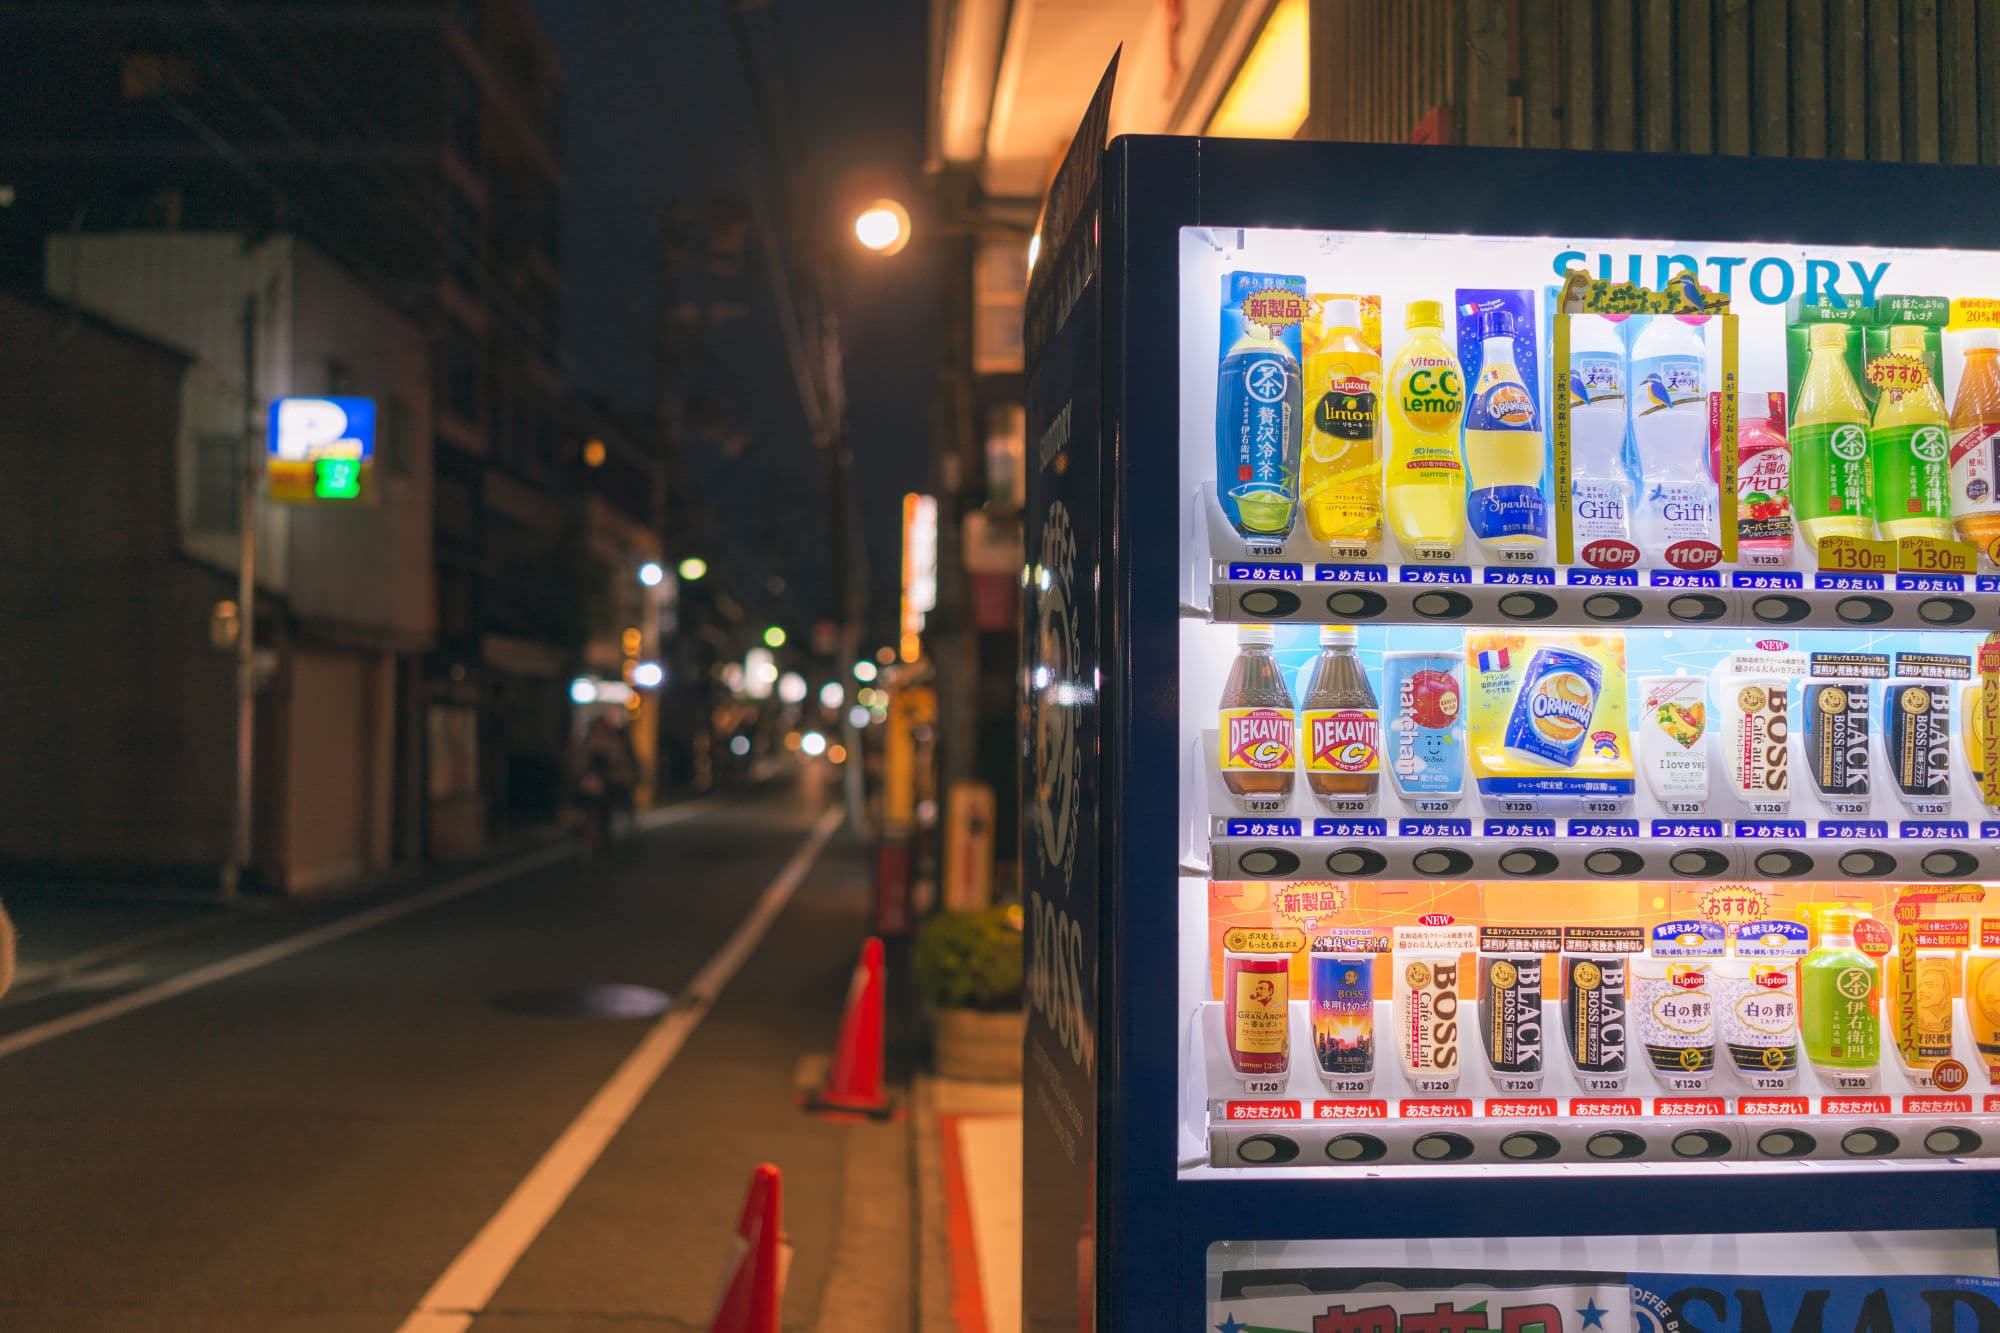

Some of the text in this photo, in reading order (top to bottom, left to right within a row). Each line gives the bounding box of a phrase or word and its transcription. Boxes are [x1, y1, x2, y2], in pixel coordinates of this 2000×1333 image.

[1553, 251, 1891, 309] SUNTORY
[1250, 299, 1303, 318] 新製品
[1872, 365, 1922, 384] おすすめ
[1334, 380, 1368, 391] Lipton
[1325, 399, 1374, 421] limon
[1404, 397, 1462, 413] Lemon
[1255, 406, 1278, 480] 贅沢冷茶
[1753, 462, 1786, 475] 太陽の
[1489, 494, 1543, 515] Sparkling
[1663, 503, 1713, 521] Gift!
[1253, 547, 1282, 555] ¥150
[1338, 549, 1367, 557] ¥150
[1422, 550, 1451, 558] ¥150
[1505, 551, 1533, 560] ¥150
[1588, 543, 1635, 562] 110円
[1671, 544, 1717, 564] 110円
[1832, 548, 1886, 568] 130円
[1912, 549, 1965, 570] 130円
[1236, 567, 1297, 581] つめたい
[1321, 569, 1381, 582] つめたい
[1406, 571, 1466, 583] つめたい
[1490, 572, 1549, 584] つめたい
[1573, 574, 1632, 586] つめたい
[1656, 575, 1715, 586] つめたい
[1738, 576, 1797, 588] つめたい
[1821, 577, 1878, 589] つめたい
[1902, 579, 1958, 591] つめたい
[1761, 640, 1785, 650] NEW
[1534, 694, 1591, 730] ORANGINA
[1400, 678, 1420, 781] natchan!
[1833, 715, 1845, 746] BOSS
[1916, 715, 1928, 746] BOSS
[1766, 688, 1787, 791] BOSS
[1846, 691, 1868, 788] BLACK
[1928, 691, 1949, 788] BLACK
[1255, 741, 1280, 763] C
[1341, 742, 1366, 764] C
[1752, 715, 1766, 789] Café au Lait
[1667, 760, 1690, 769] love
[1505, 803, 1532, 811] ¥120
[1588, 803, 1615, 811] ¥120
[1672, 804, 1698, 812] ¥120
[1754, 804, 1781, 812] ¥120
[1836, 804, 1862, 812] ¥120
[1234, 824, 1295, 836] つめたい
[1320, 824, 1380, 836] つめたい
[1406, 825, 1464, 836] つめたい
[1490, 825, 1549, 836] つめたい
[1574, 825, 1632, 836] つめたい
[1658, 826, 1716, 836] つめたい
[1741, 826, 1800, 837] つめたい
[1824, 827, 1882, 837] つめたい
[1906, 827, 1963, 837] つめたい
[1284, 892, 1336, 912] 新製品
[1708, 898, 1760, 917] おすすめ
[1425, 915, 1449, 925] NEW
[1741, 924, 1805, 937] 贅沢ミルクティー
[1031, 890, 1084, 1065] BOSS
[1675, 976, 1704, 985] Lipton
[1758, 976, 1787, 985] Lipton
[1338, 989, 1364, 998] BOSS
[1504, 990, 1515, 1022] BOSS
[1588, 990, 1600, 1023] BOSS
[1238, 1010, 1262, 1020] GRAN
[1434, 962, 1457, 1069] BOSS
[1517, 966, 1540, 1065] BLACK
[1601, 966, 1624, 1066] BLACK
[1420, 992, 1432, 1067] Café au Lait
[1846, 1001, 1865, 1059] 伊右衛門
[1251, 1082, 1278, 1091] ¥120
[1336, 1082, 1364, 1090] ¥120
[1422, 1081, 1449, 1090] ¥120
[1507, 1081, 1533, 1089] ¥120
[1591, 1080, 1618, 1089] ¥120
[1674, 1080, 1701, 1088] ¥120
[1757, 1079, 1783, 1087] ¥120
[1839, 1079, 1865, 1087] ¥120
[1233, 1105, 1295, 1118] あたたかい
[1320, 1105, 1380, 1118] あたたかい
[1406, 1105, 1466, 1117] あたたかい
[1491, 1104, 1551, 1116] あたたかい
[1576, 1103, 1635, 1116] あたたかい
[1660, 1103, 1719, 1115] あたたかい
[1744, 1102, 1803, 1114] あたたかい
[1827, 1102, 1885, 1113] あたたかい
[1909, 1101, 1967, 1112] あたたかい
[1633, 1288, 1673, 1318] OFFEE
